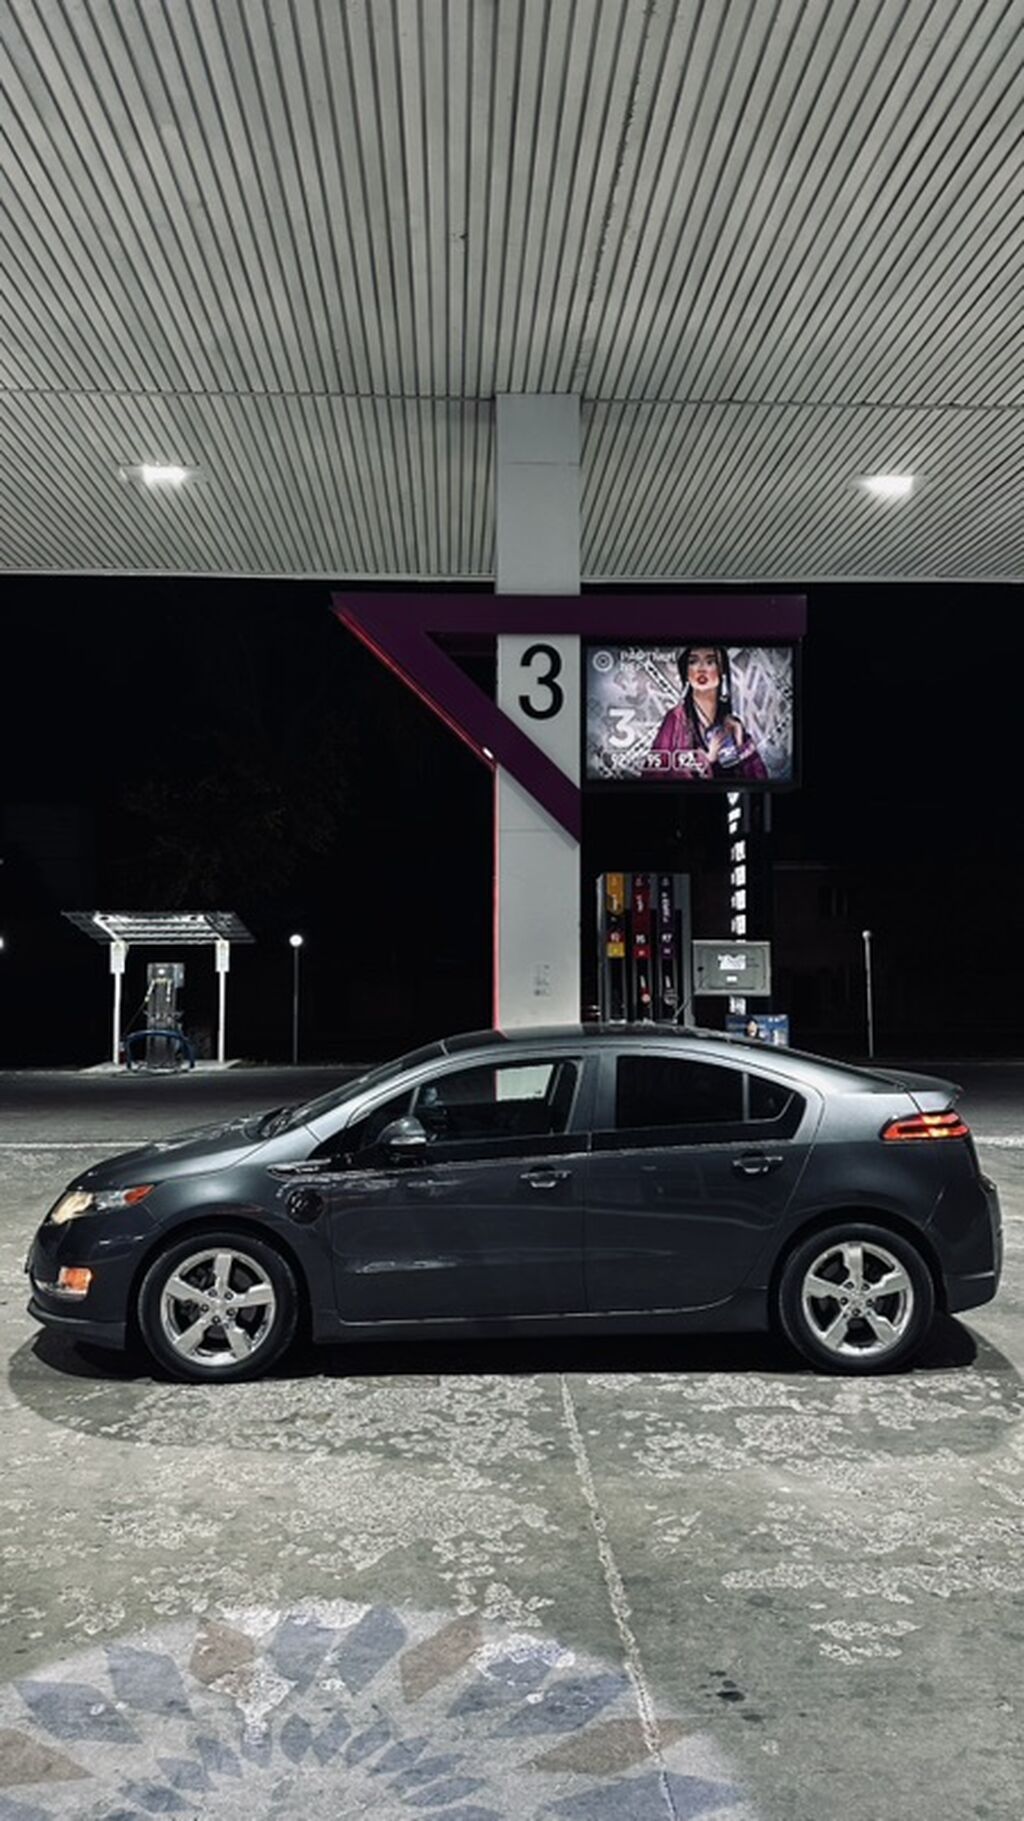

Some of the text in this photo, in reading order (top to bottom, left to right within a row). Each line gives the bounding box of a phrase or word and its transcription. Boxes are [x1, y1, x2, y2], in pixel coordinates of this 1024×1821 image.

[519, 643, 563, 720] 3
[609, 708, 635, 749] 3
[647, 753, 662, 768] 95
